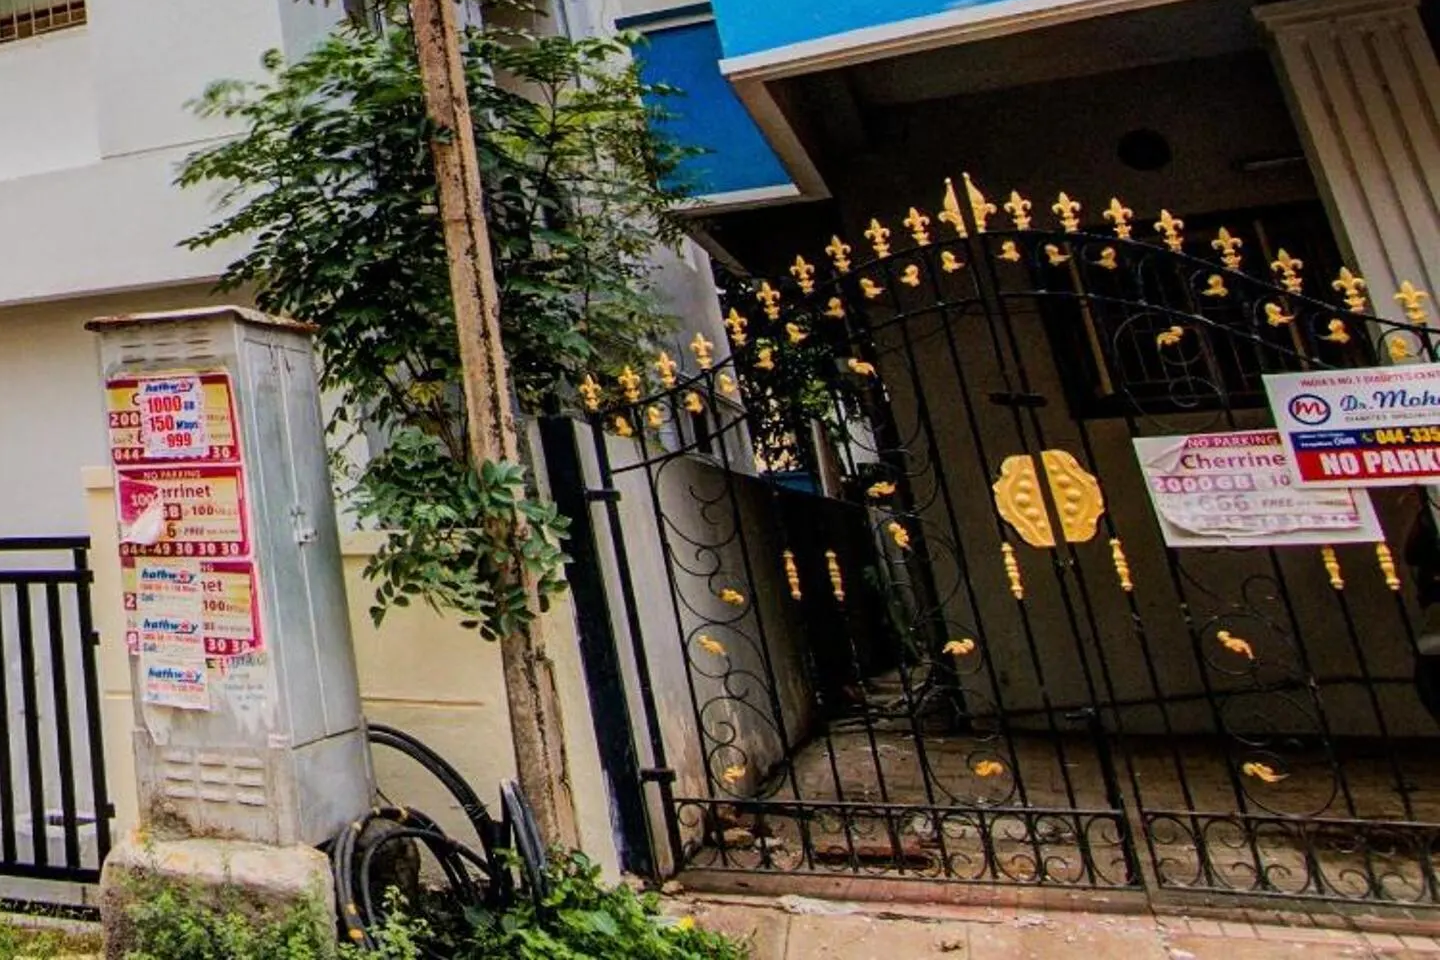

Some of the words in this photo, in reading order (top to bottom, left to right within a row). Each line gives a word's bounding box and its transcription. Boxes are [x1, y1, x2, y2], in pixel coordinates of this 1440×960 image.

[150, 415, 174, 431] 150
[1187, 437, 1209, 448] NO
[1214, 433, 1279, 447] PARKING
[1318, 452, 1360, 476] NO
[175, 543, 194, 555] 30
[199, 543, 217, 555] 30
[221, 543, 240, 555] 30
